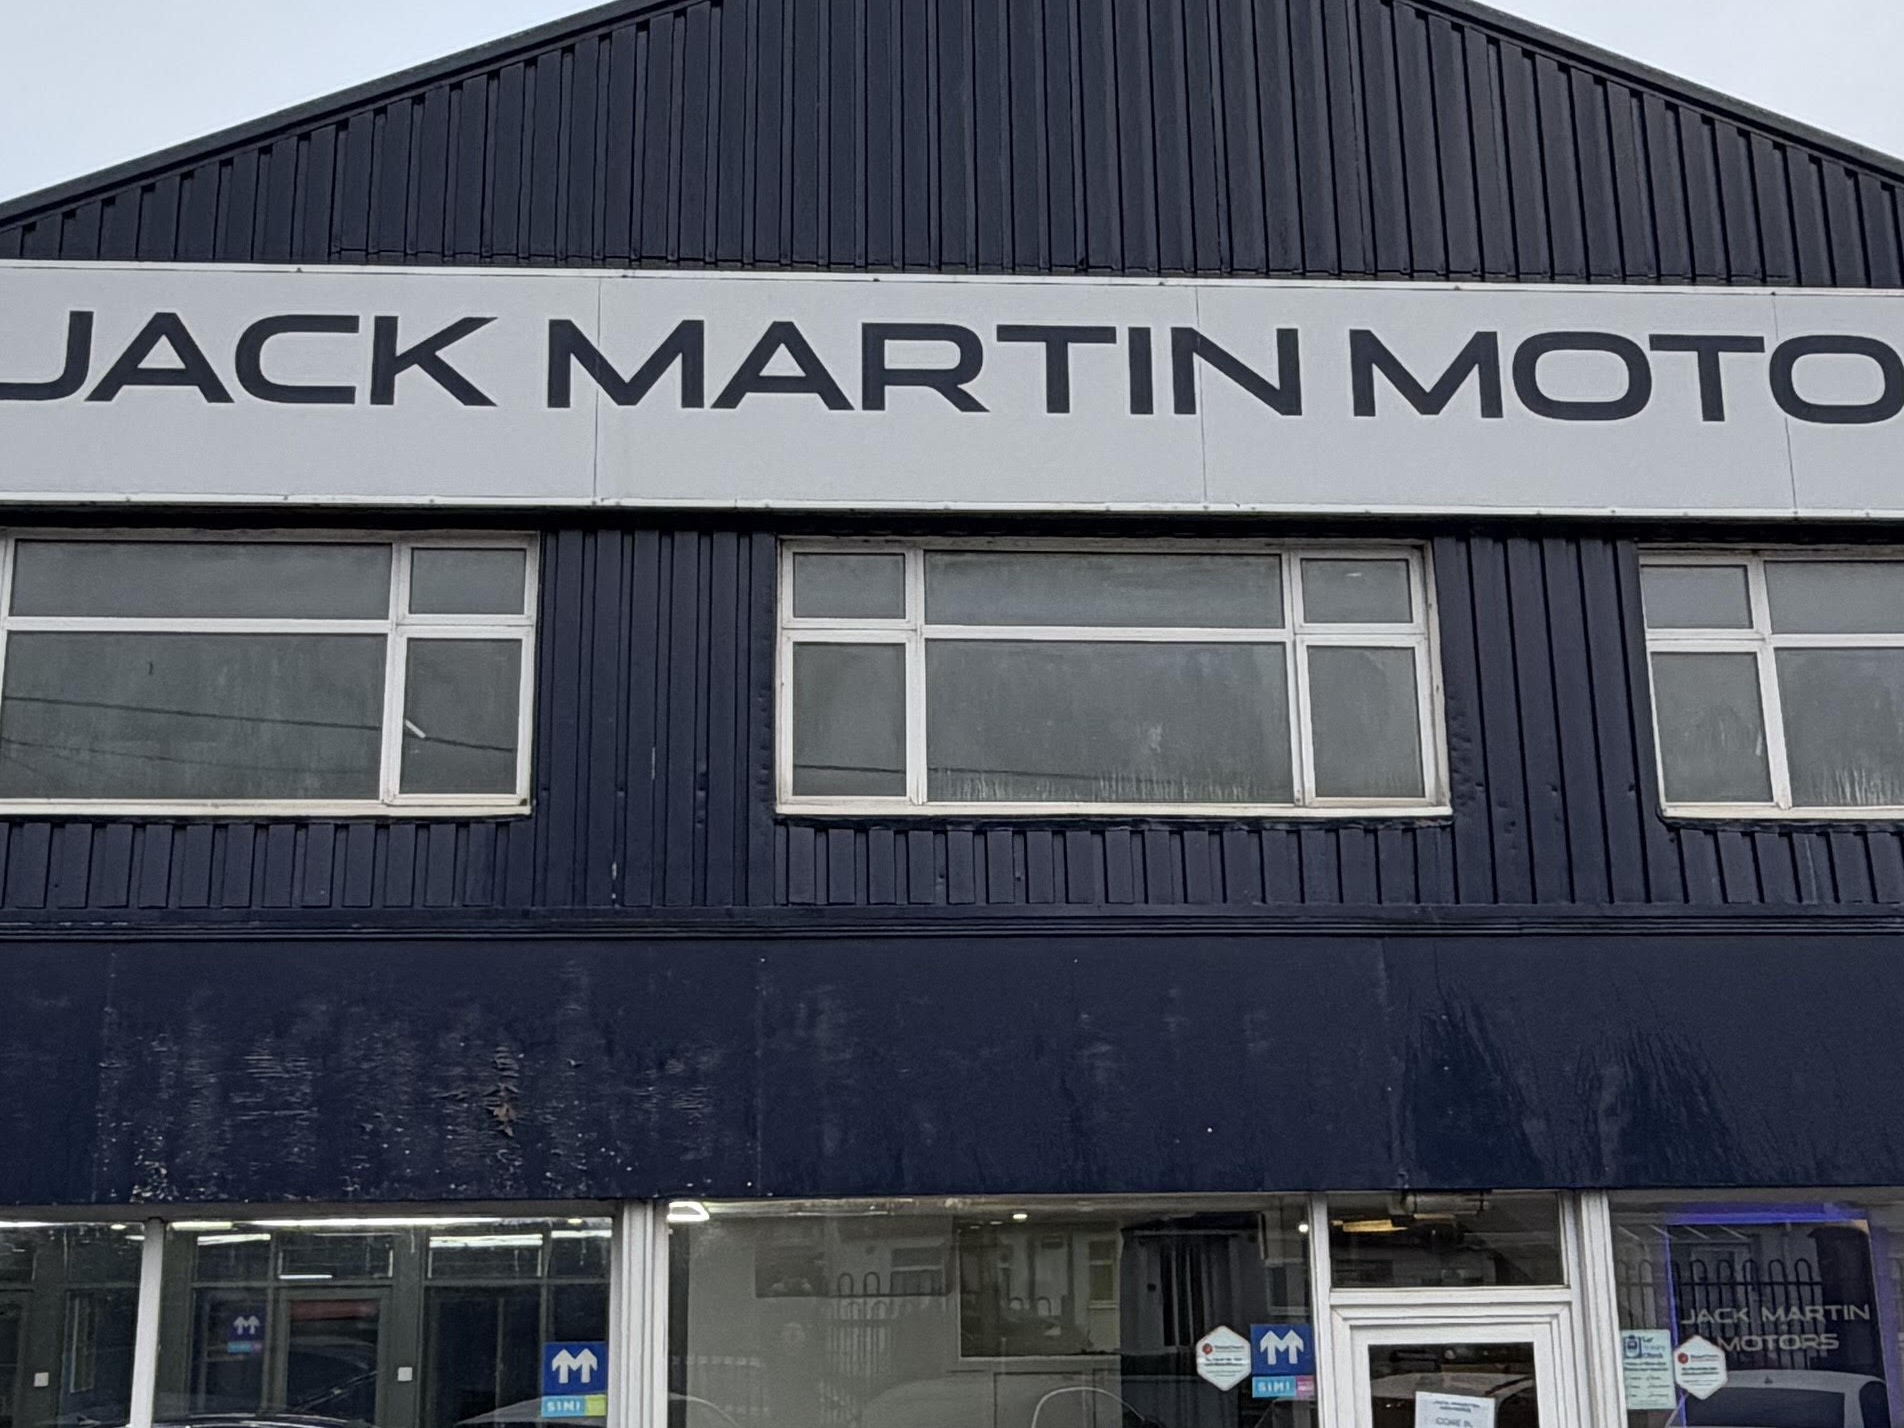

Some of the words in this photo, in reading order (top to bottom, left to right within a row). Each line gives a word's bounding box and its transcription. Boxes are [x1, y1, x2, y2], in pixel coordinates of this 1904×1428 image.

[547, 319, 1303, 416] MARTIN
[1680, 1307, 1750, 1324] JACK
[1761, 1304, 1871, 1322] MARTIN
[1717, 1333, 1839, 1352] MOTORS
